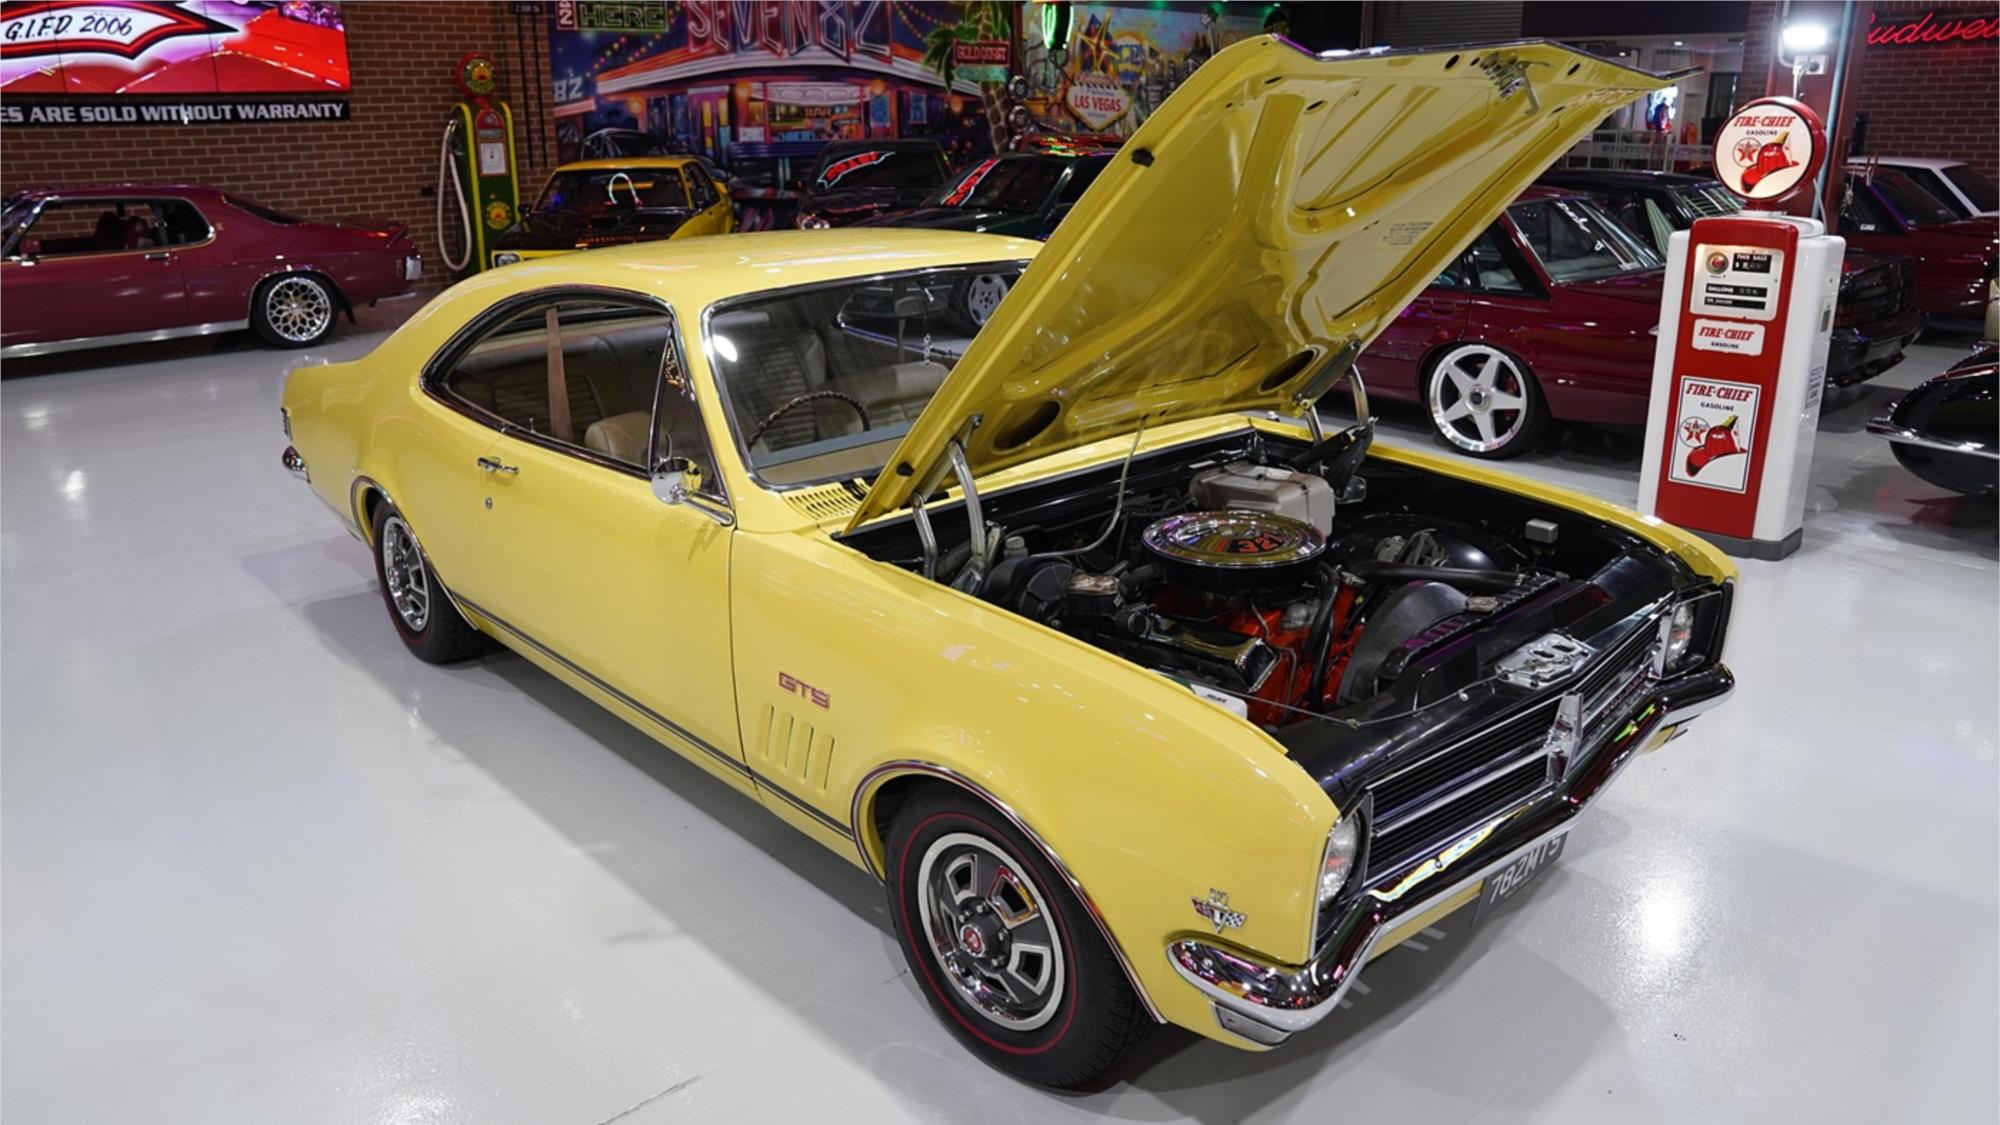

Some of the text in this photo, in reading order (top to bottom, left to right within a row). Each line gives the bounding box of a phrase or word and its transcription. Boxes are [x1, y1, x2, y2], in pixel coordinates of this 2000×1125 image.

[79, 15, 133, 36] 2006
[579, 4, 664, 28] HERE
[30, 106, 77, 122] ARE
[81, 106, 138, 121] SOLD
[140, 104, 233, 122] WITHOUT
[236, 102, 344, 120] WARRANTY
[1074, 94, 1121, 112] LAS VEGAS
[1733, 115, 1797, 127] FIRE-CHIEF
[1698, 326, 1755, 341] FIRE-CHIEF
[1711, 341, 1740, 349] GASOLINE
[1685, 382, 1754, 402] FIRE-CHIEF
[1700, 401, 1735, 412] GASOLINE
[779, 671, 830, 709] GTS
